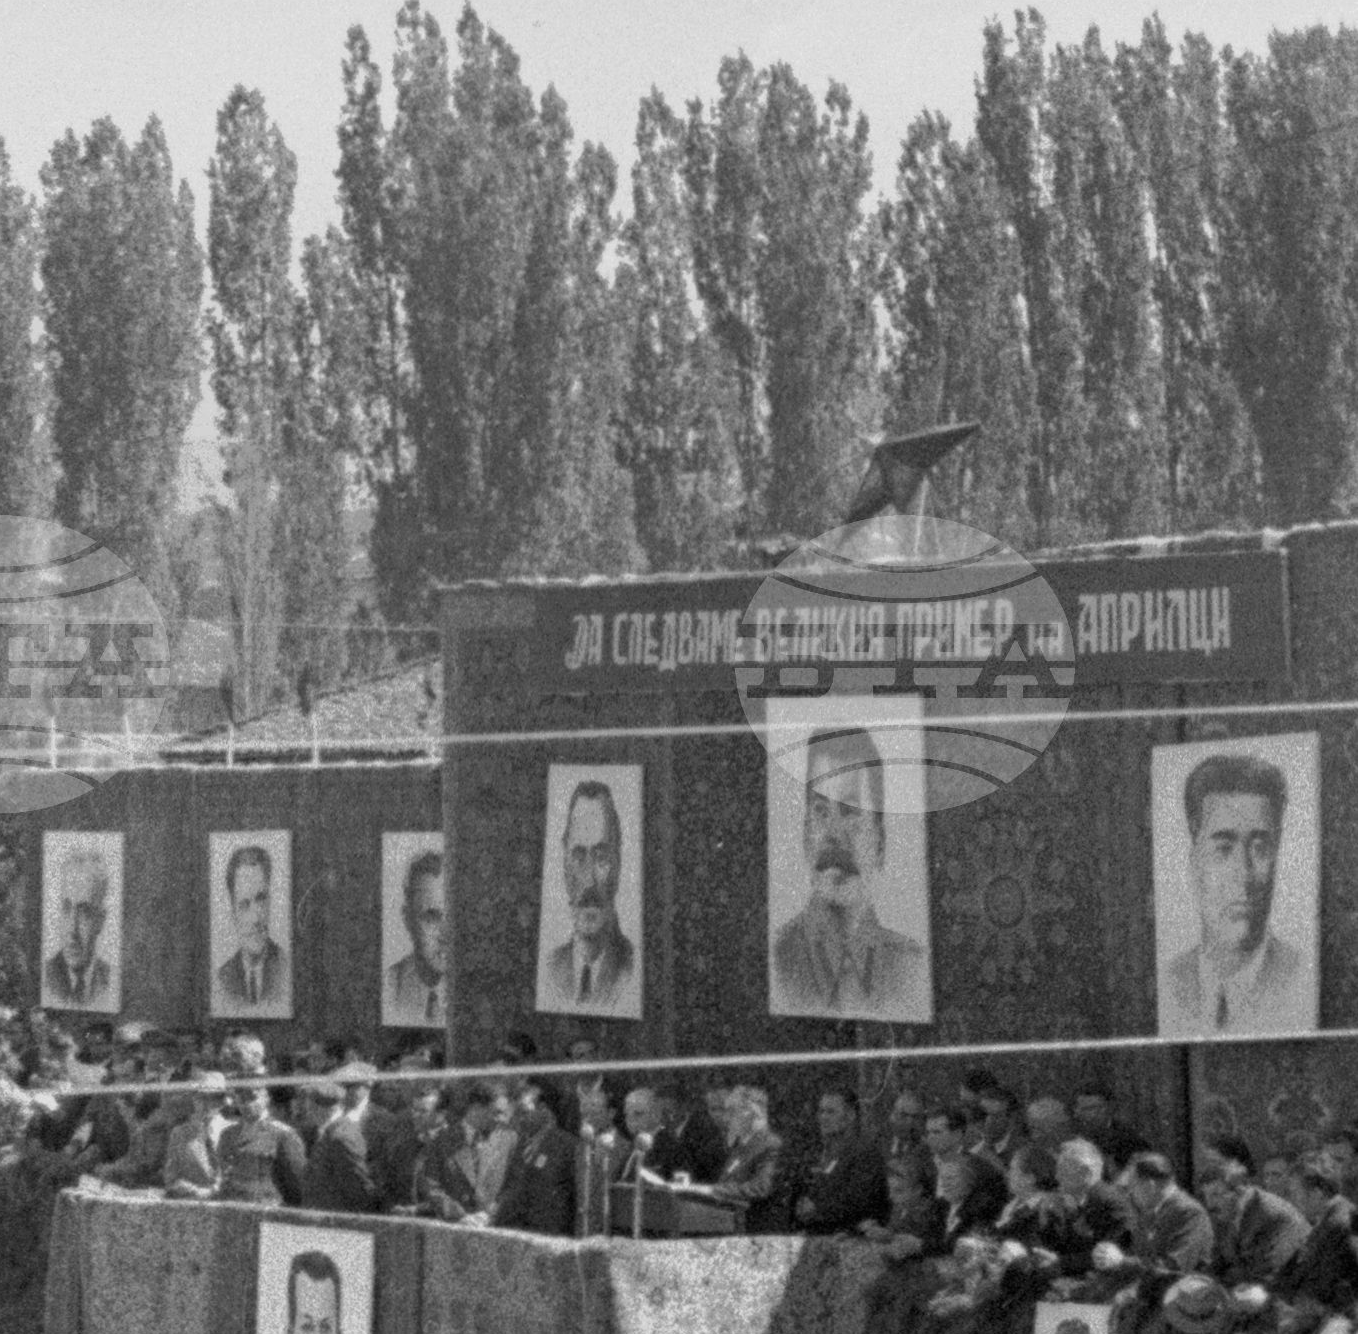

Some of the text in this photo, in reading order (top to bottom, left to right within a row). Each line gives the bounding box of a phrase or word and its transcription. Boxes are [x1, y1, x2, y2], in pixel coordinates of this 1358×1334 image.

[564, 613, 604, 670] ДА
[612, 607, 744, 671] СЛЕДВАМЕ
[755, 603, 885, 662] ВЕЛИКИЯ
[896, 598, 1013, 661] ПРИМЕР
[1077, 586, 1231, 657] АПРИЛЦИ
